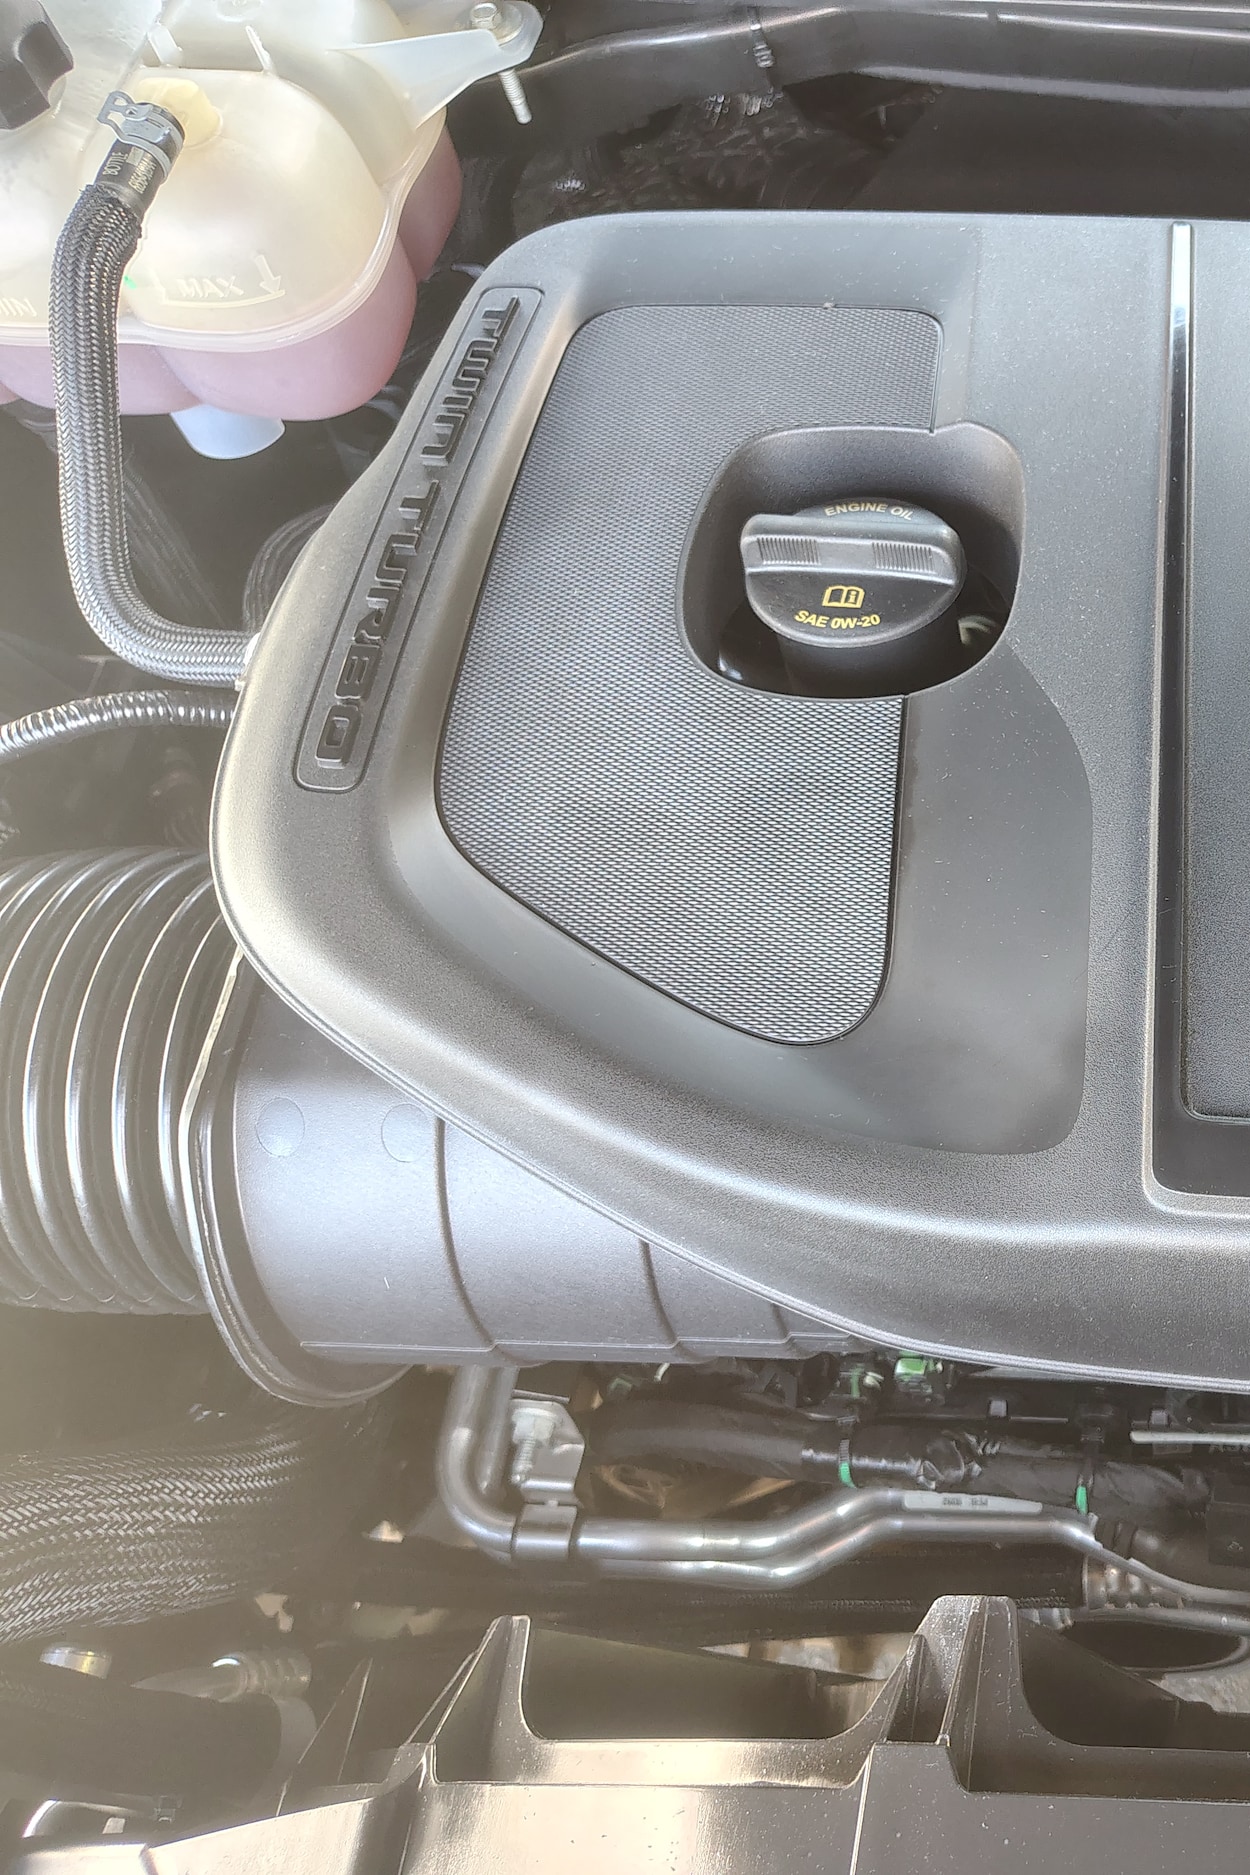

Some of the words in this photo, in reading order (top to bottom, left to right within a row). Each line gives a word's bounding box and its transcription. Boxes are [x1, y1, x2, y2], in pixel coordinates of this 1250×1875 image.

[103, 152, 128, 176] BOTTLE
[176, 275, 244, 298] MAX
[420, 296, 520, 467] TWIN
[824, 503, 888, 517] ENGINE
[890, 506, 913, 521] OIL
[315, 480, 441, 768] TURBO
[794, 610, 830, 628] SAE
[831, 614, 881, 629] 0W-20
